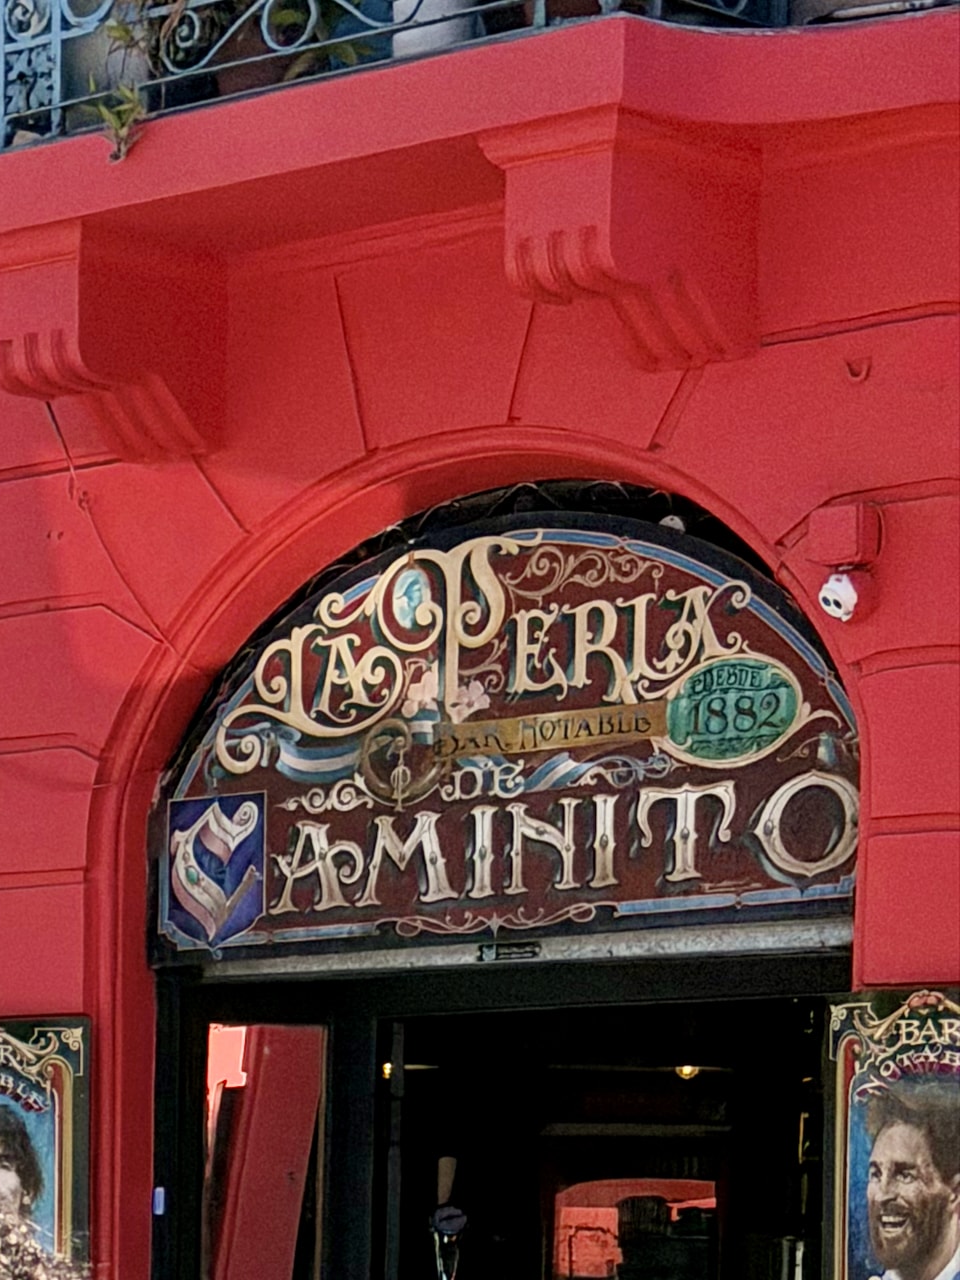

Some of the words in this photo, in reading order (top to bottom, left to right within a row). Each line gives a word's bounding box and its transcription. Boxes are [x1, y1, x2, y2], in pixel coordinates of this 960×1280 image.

[370, 530, 750, 721] PERLA
[691, 665, 762, 693] DESDE
[691, 692, 786, 736] 1882
[441, 759, 525, 801] DE
[170, 770, 860, 943] CAMINITO
